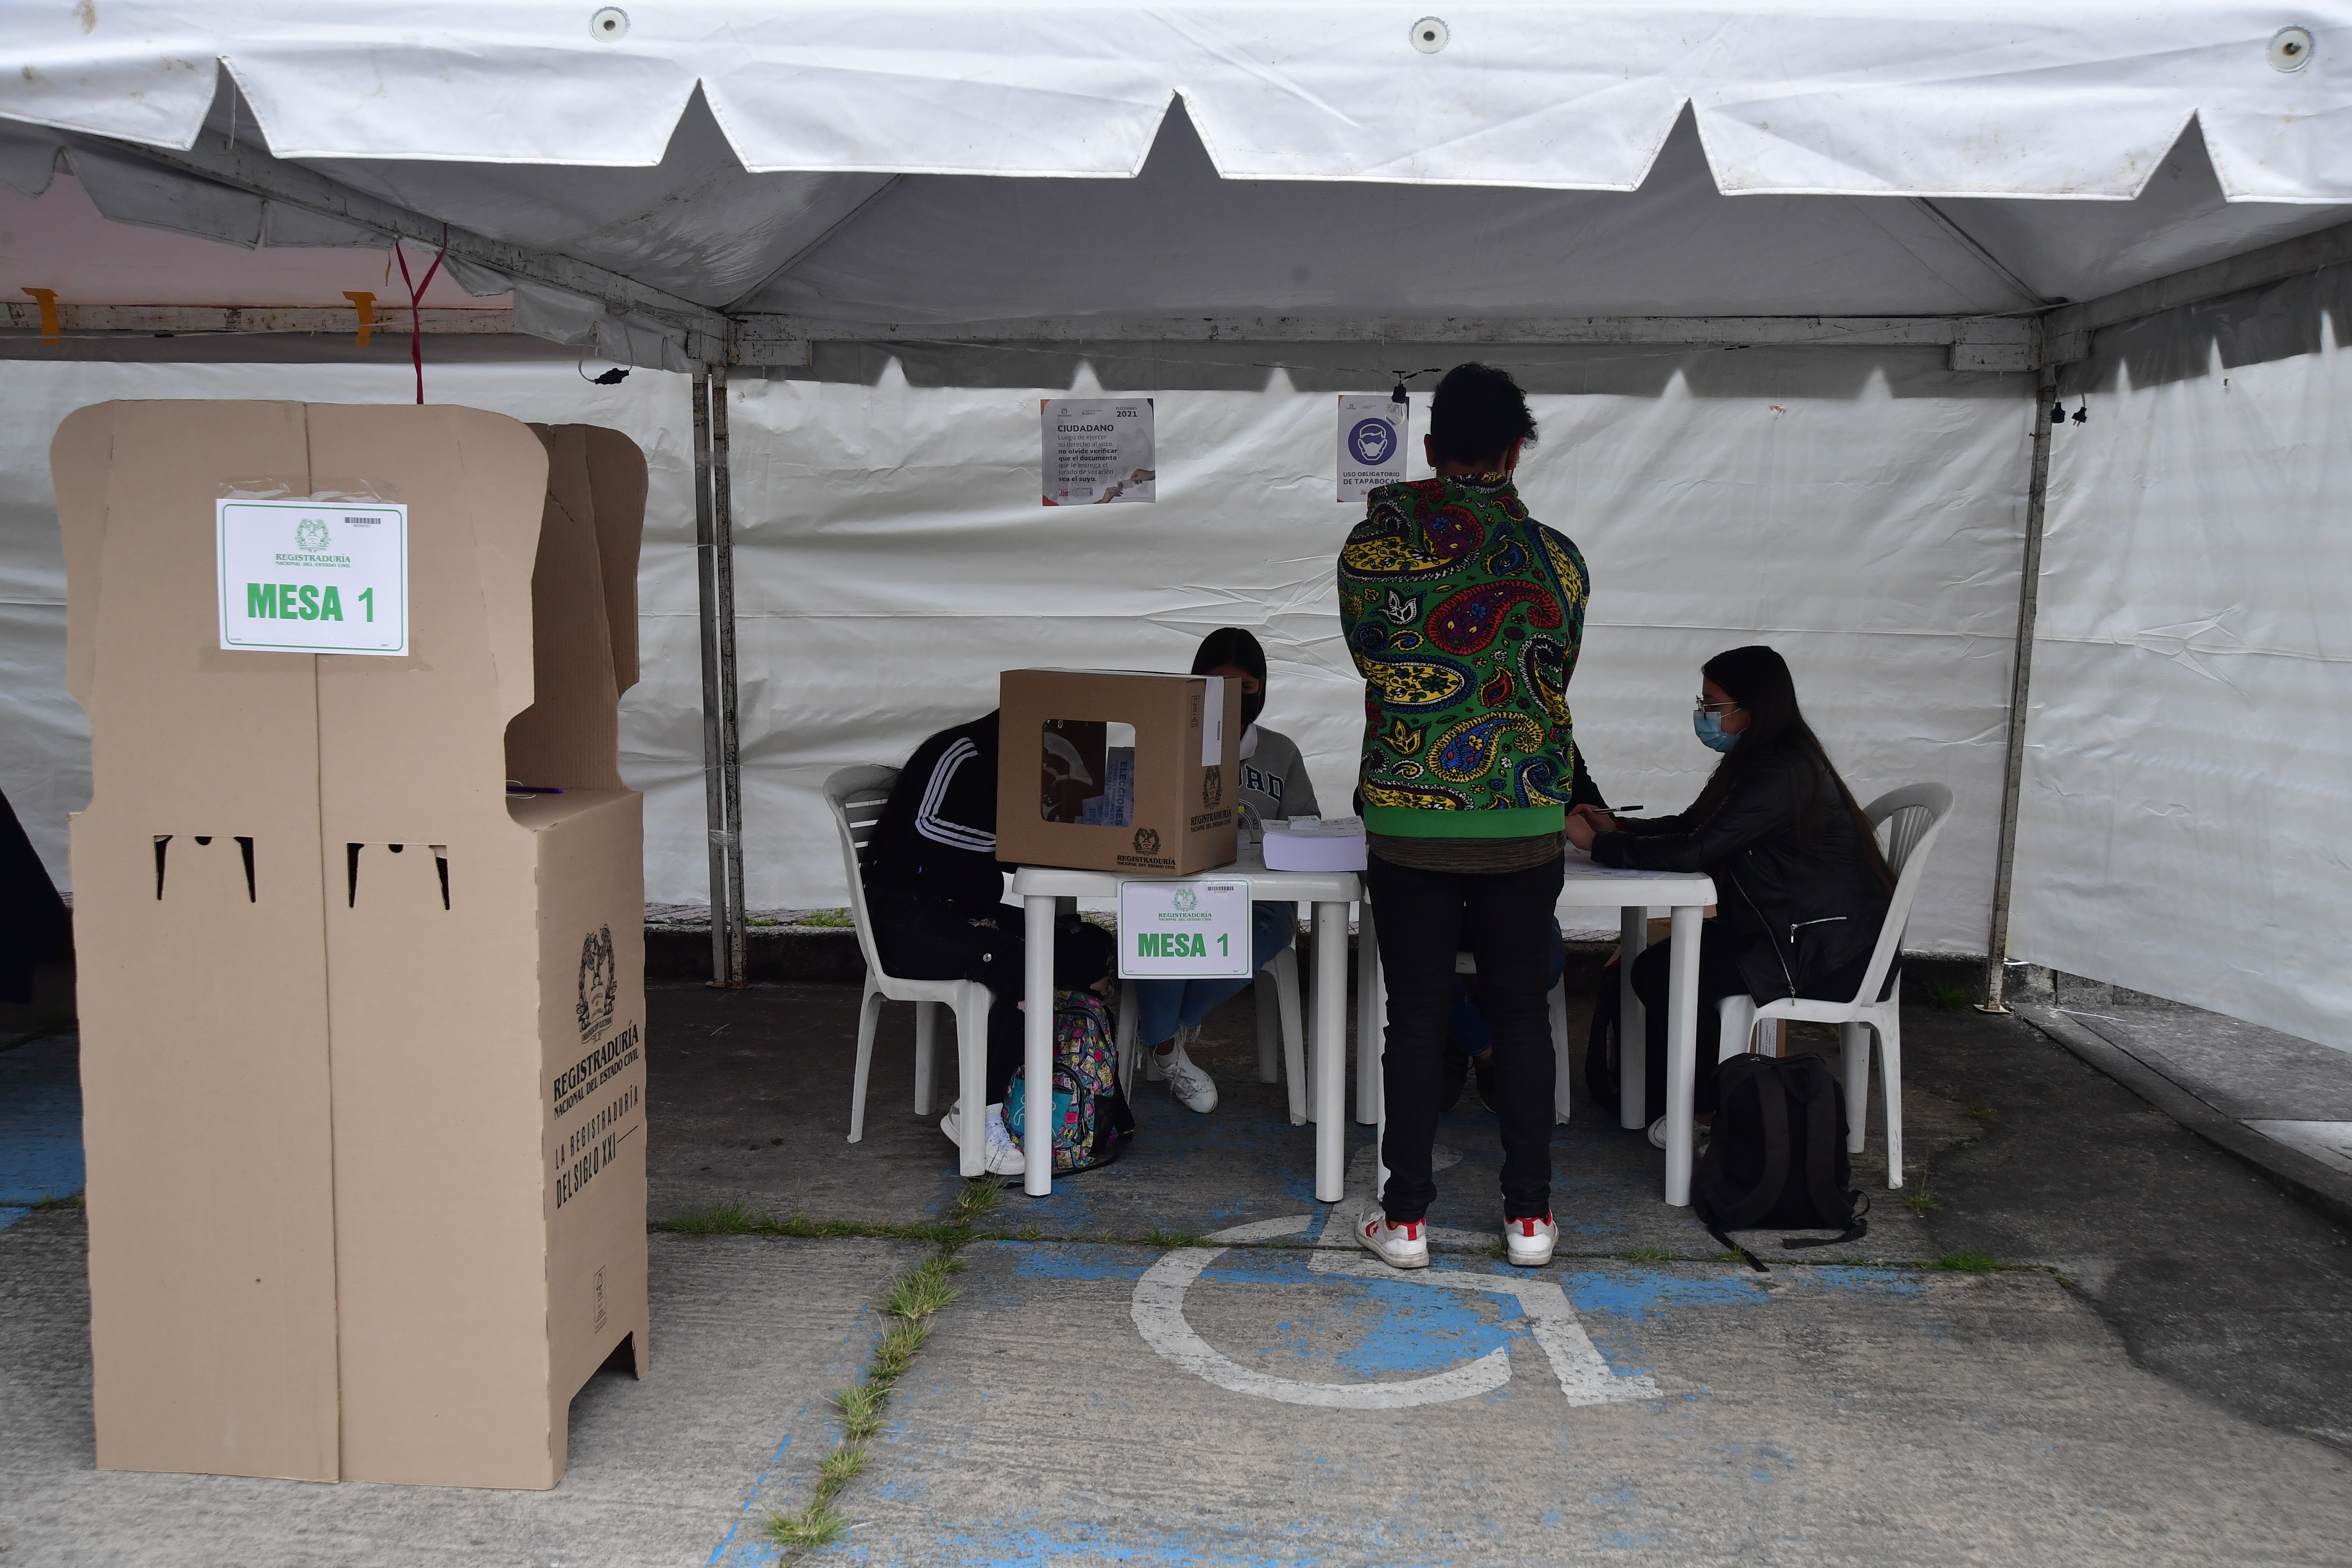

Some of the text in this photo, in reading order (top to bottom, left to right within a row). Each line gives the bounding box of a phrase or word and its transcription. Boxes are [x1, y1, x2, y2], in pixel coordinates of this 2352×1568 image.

[276, 553, 351, 563] REGISTRADURÍA
[247, 583, 373, 622] MESA 1
[1115, 761, 1127, 825] ELECCIONES
[1239, 764, 1285, 803] RD
[1191, 806, 1232, 826] REGISTRADURÍA
[1117, 855, 1176, 865] REGISTRADURÍA
[1138, 933, 1228, 957] MESA 1
[554, 1019, 639, 1103] REGISTRADURÍA
[554, 1047, 639, 1121] NACIONAL DEL ESTADO CIVIL
[556, 1084, 638, 1171] LA REGISTRADURÍA
[557, 1132, 616, 1209] DEL SIGLO XXI
